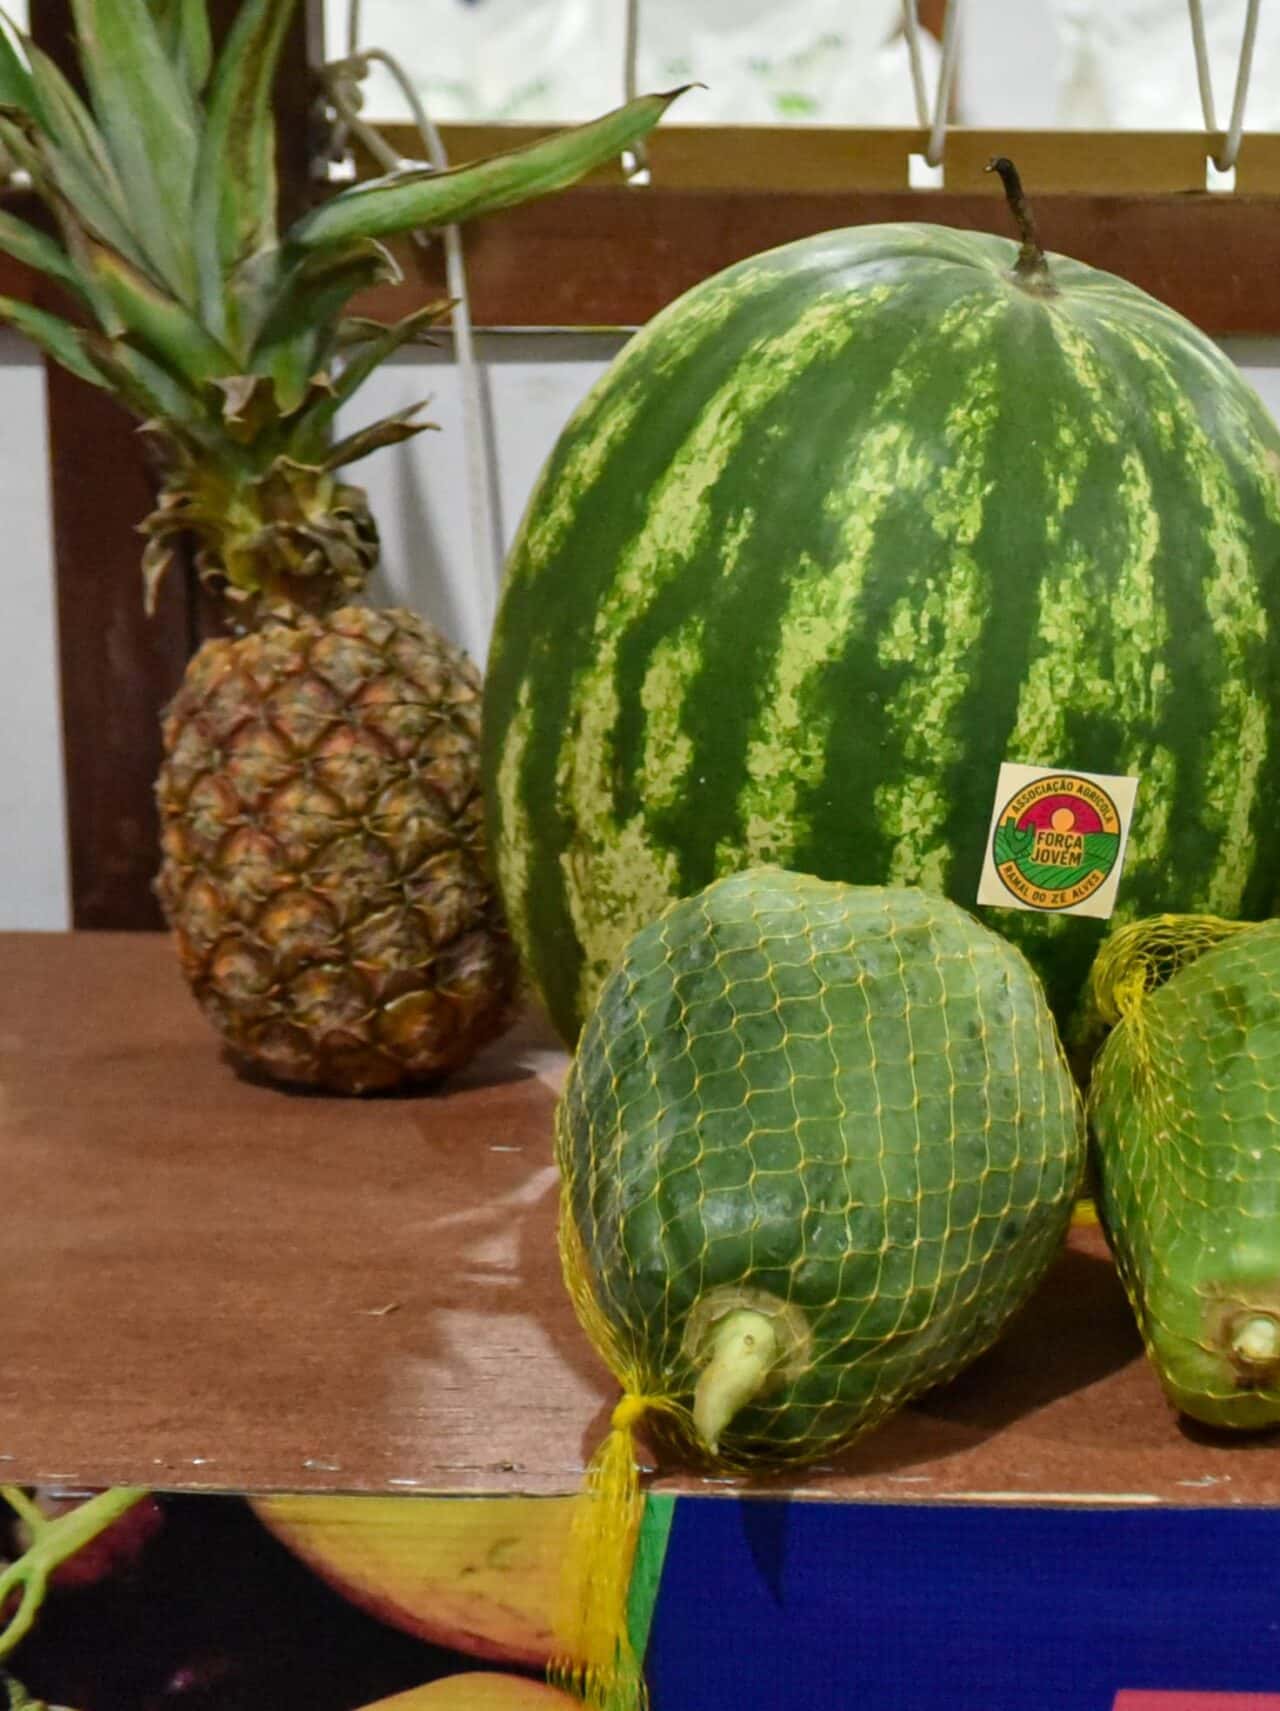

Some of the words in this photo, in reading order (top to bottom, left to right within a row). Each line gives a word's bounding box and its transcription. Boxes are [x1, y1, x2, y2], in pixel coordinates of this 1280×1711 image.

[1011, 779, 1074, 815] ASSOCIAÇÃO
[1036, 831, 1083, 853] FORÇA
[1031, 848, 1082, 866] JOVEM
[1003, 864, 1029, 897] RAMAL
[1072, 873, 1100, 898] ALVES
